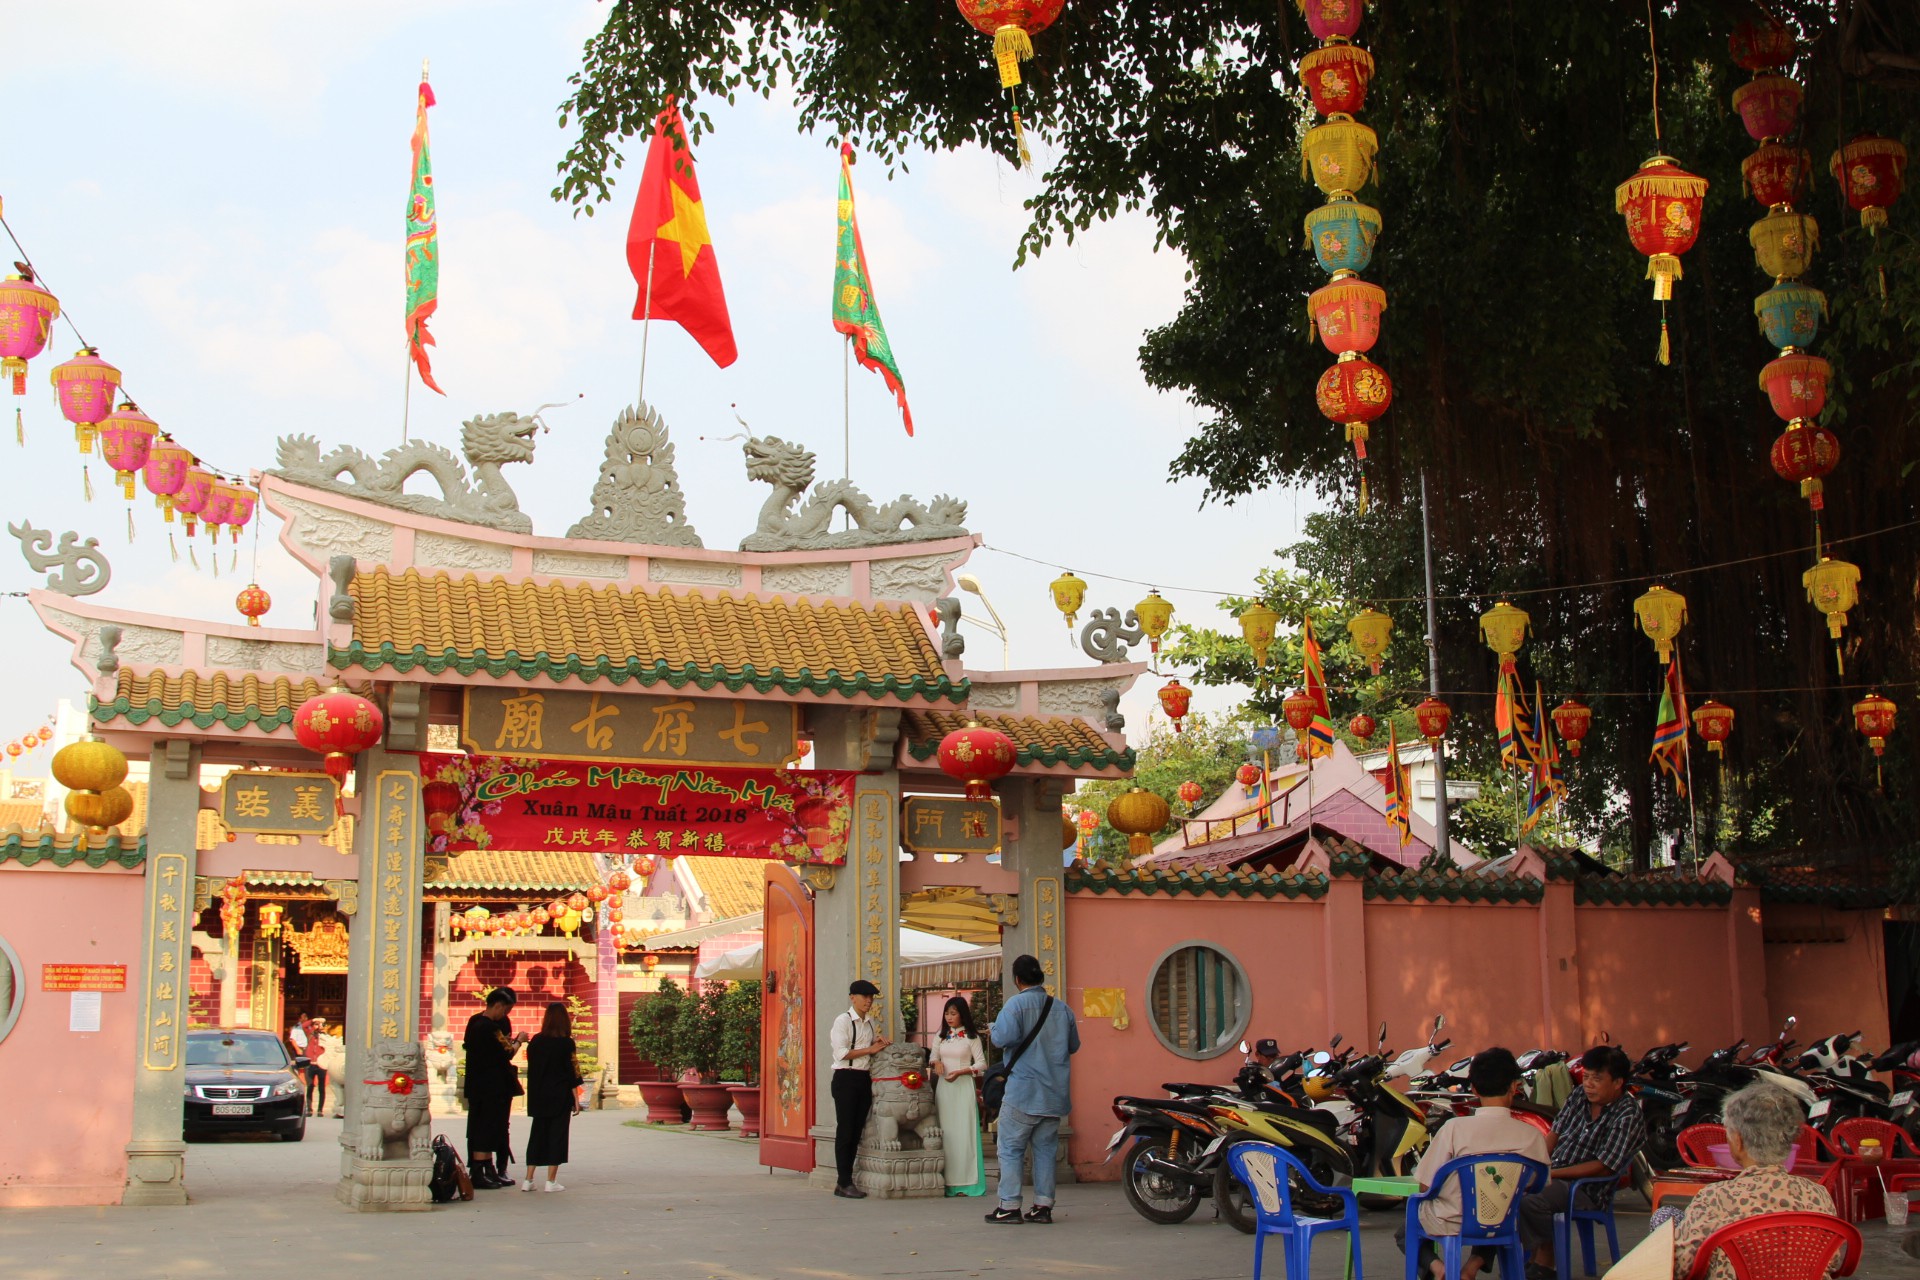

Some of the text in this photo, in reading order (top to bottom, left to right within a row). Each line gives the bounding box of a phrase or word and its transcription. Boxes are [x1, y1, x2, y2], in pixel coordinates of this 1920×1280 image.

[495, 686, 770, 757] 七府古廟
[476, 771, 580, 801] Chúc
[587, 766, 673, 805] Mừng
[670, 771, 739, 803] Năm
[522, 800, 748, 823] Xuân Mậu Tuất 2018
